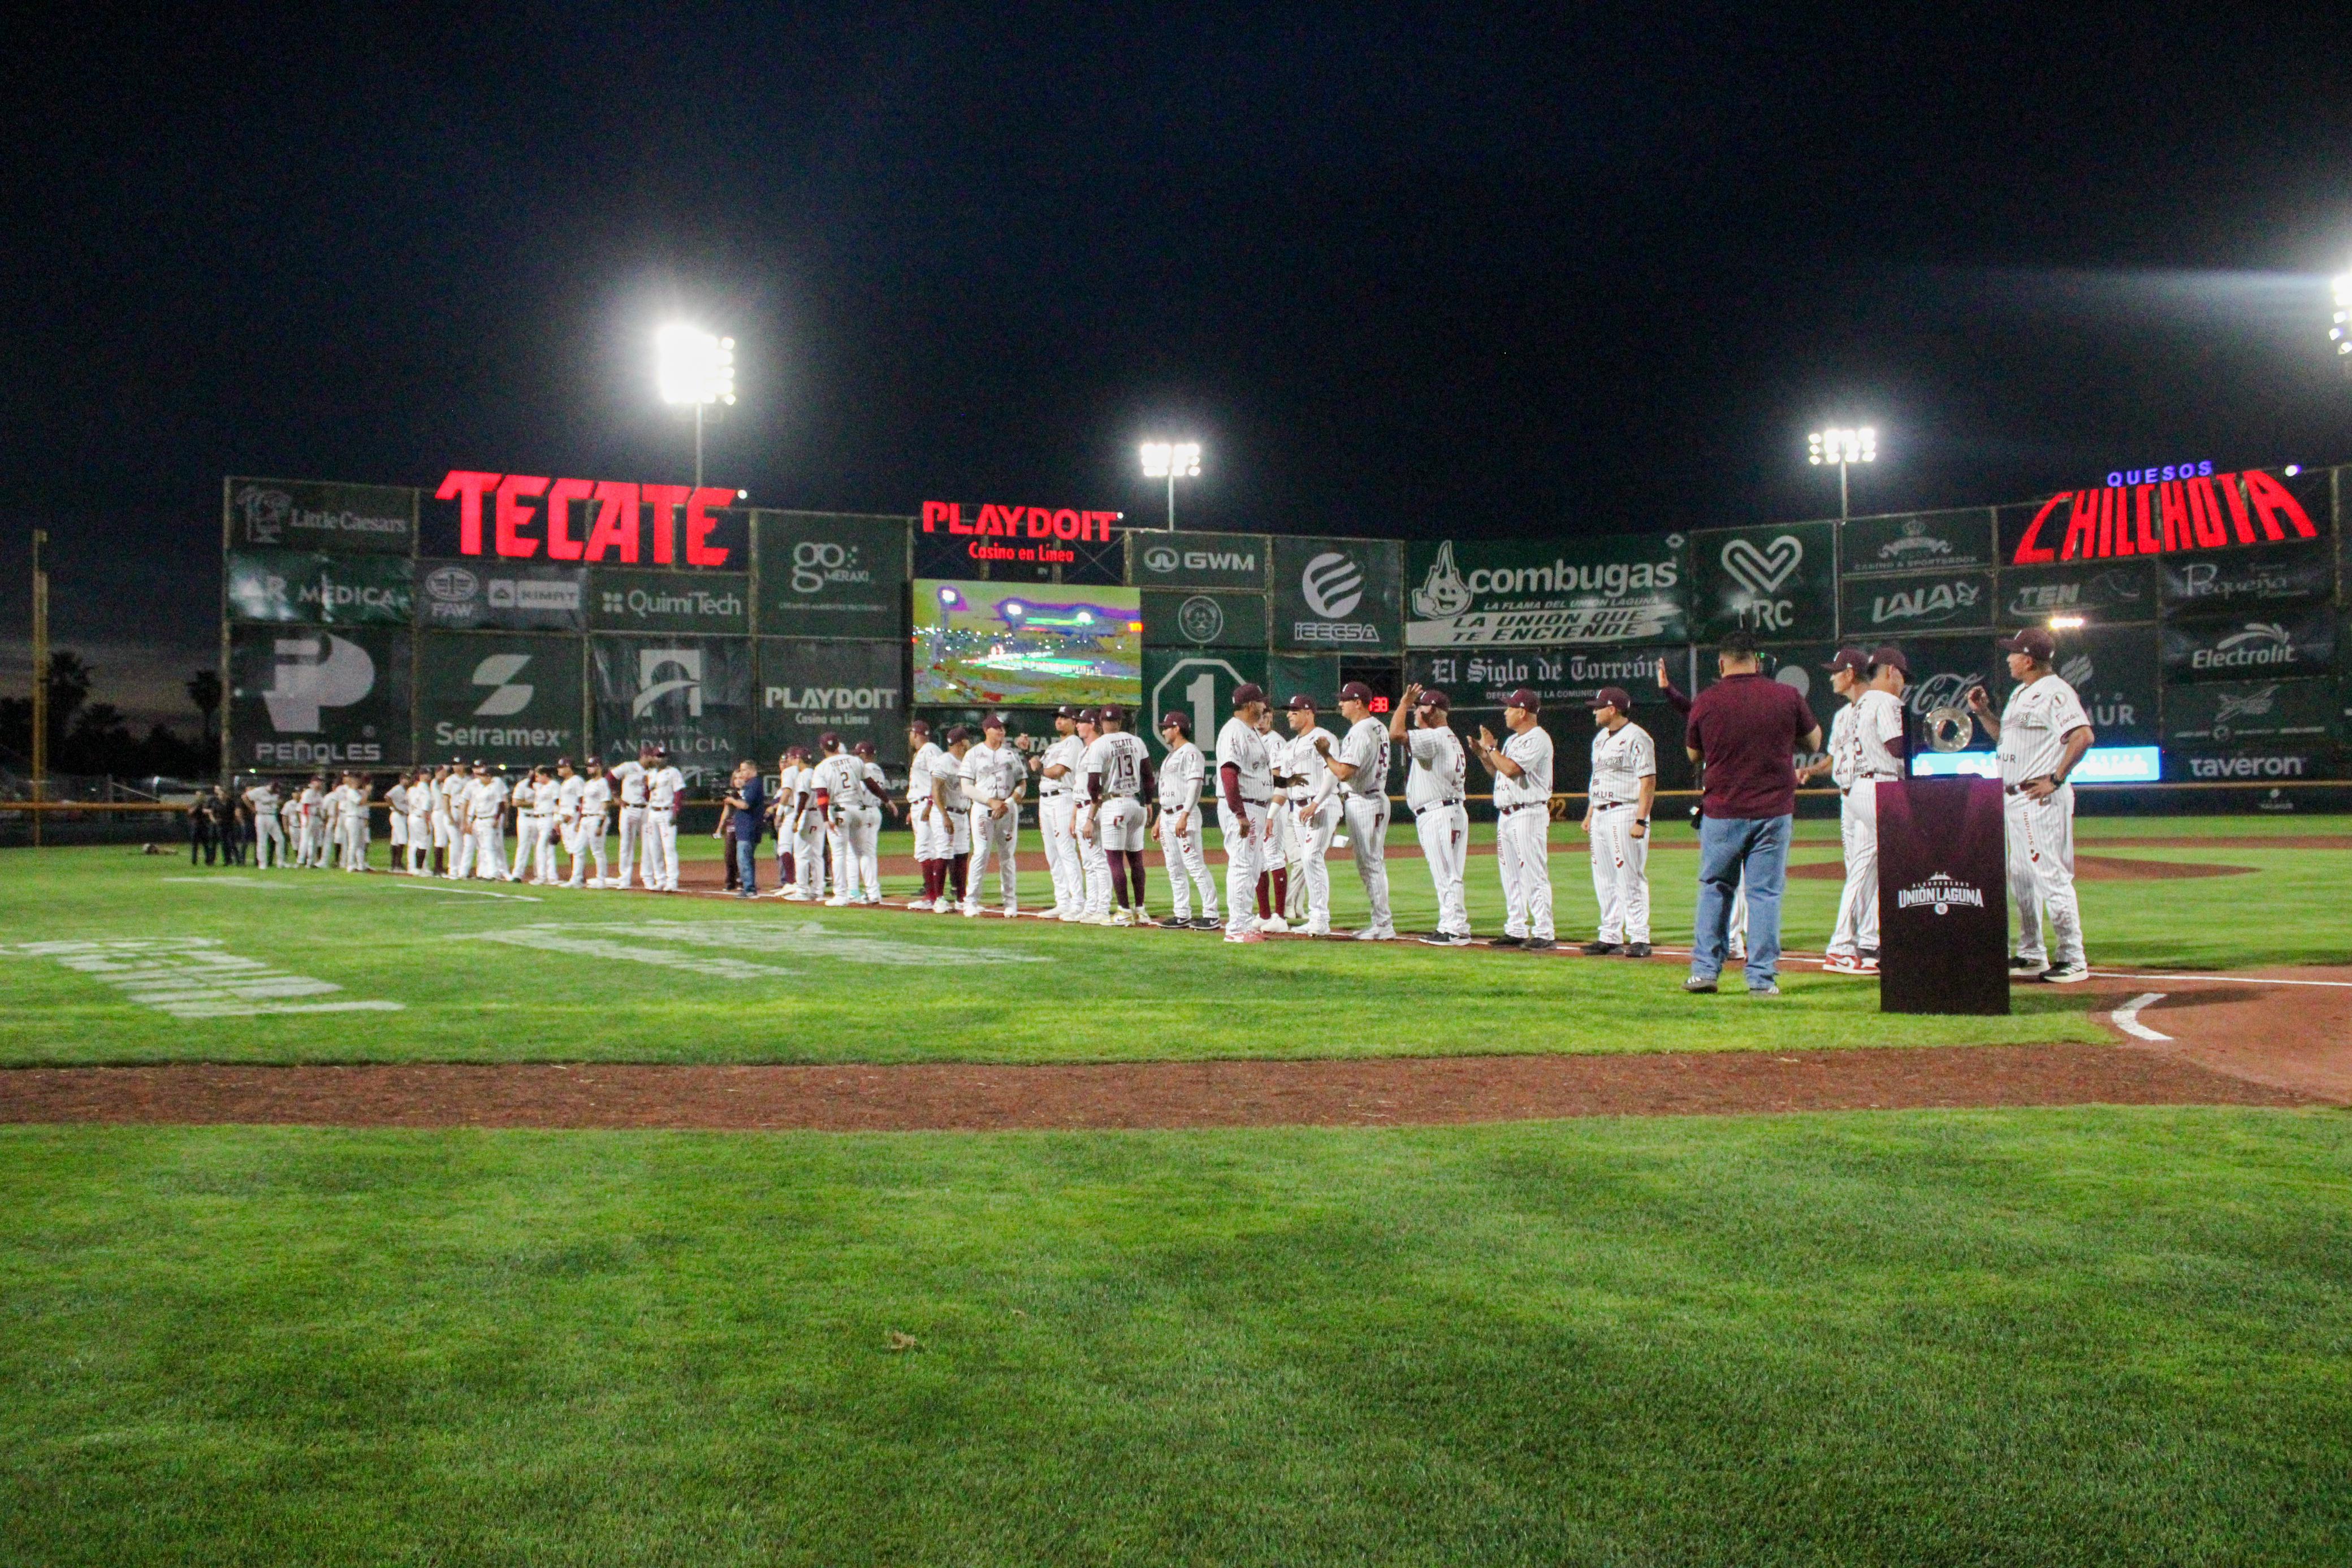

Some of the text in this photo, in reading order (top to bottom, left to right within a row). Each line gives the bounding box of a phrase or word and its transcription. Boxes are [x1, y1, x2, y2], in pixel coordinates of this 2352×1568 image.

[2107, 460, 2213, 487] QUESOS
[435, 470, 737, 565] TECATE
[923, 501, 1117, 542] PLAYDOIT
[2013, 470, 2318, 565] CHILCHOTA
[969, 542, 1015, 560] Casino
[1018, 547, 1034, 561] en
[1184, 552, 1254, 571] GWM
[823, 569, 869, 582] MERAKI
[1469, 558, 1677, 597] combugas
[432, 603, 474, 618] FAW
[628, 590, 741, 618] QuimiTech
[1483, 602, 1499, 611] LA
[1501, 600, 1541, 610] FLAMA
[1544, 599, 1566, 609] DEL
[1610, 596, 1660, 607] LAGUNA
[1871, 584, 1956, 623] LALA
[1454, 609, 1646, 628] LA UNION QUE
[1453, 622, 1638, 642] TE ENCIENDE
[2193, 644, 2298, 669] Electrolit
[1432, 659, 1457, 683] El
[1468, 657, 1529, 688] Siglo
[1538, 657, 1563, 681] de
[766, 686, 898, 709] PLAYDOIT
[1544, 690, 1555, 698] LA
[795, 712, 827, 724] Casino
[830, 715, 841, 724] en
[1186, 673, 1214, 751] 1
[1110, 738, 1133, 748] TECATE
[1118, 755, 1134, 778] 13
[840, 772, 851, 789] 2
[1612, 825, 1621, 855] Soriana
[2024, 811, 2035, 846] Soriana
[1898, 886, 1984, 908] UNIÓN LAGUNA
